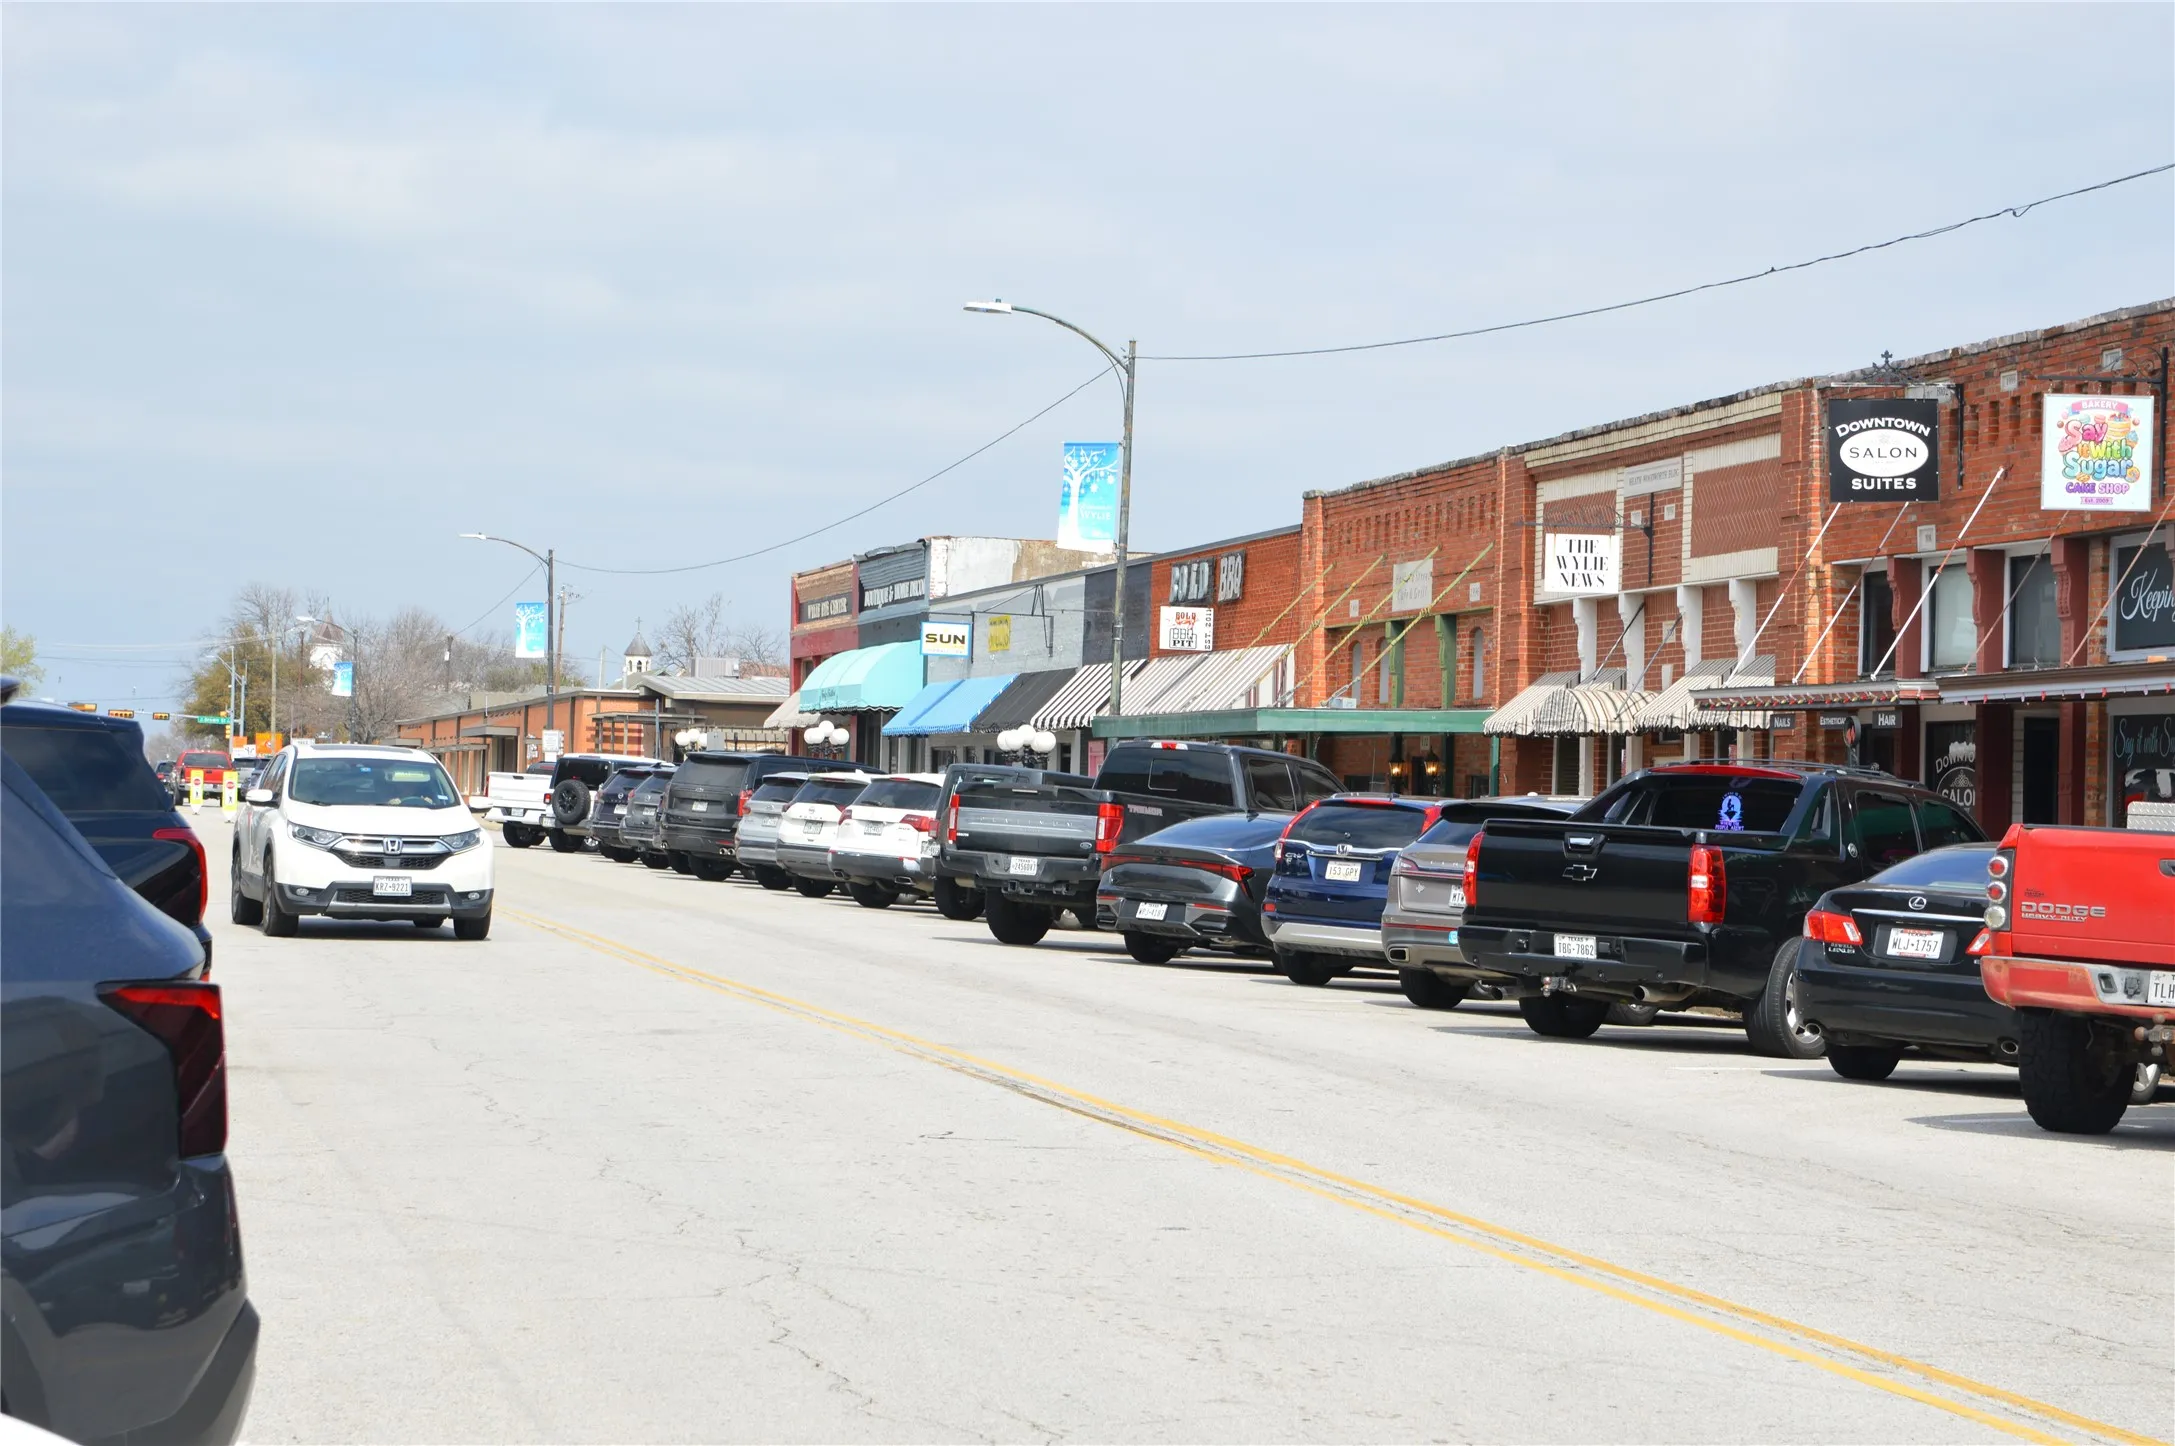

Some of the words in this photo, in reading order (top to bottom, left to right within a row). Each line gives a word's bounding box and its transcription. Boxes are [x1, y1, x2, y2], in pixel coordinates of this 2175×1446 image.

[2081, 400, 2118, 409] BAKERY
[1835, 417, 1931, 437] DOWNTOWN
[2058, 420, 2108, 452] Say
[1849, 447, 1917, 458] SALON
[2062, 451, 2133, 481] Sugar
[1851, 478, 1917, 490] SUITES
[2065, 482, 2096, 493] CAKE
[2098, 483, 2130, 494] SHOP
[1565, 539, 1600, 554] THE
[1556, 555, 1609, 571] WYLIE
[1218, 553, 1243, 601] BBQ
[1560, 572, 1605, 587] NEWS
[1175, 611, 1197, 621] BOLD
[925, 633, 966, 645] SUN
[1172, 628, 1194, 640] BBQ
[1774, 716, 1791, 728] NAILS
[1878, 714, 1896, 726] HAIR
[1127, 804, 1164, 817] TREMOR
[2021, 901, 2106, 917] DODGE
[2021, 912, 2057, 920] HEAVY
